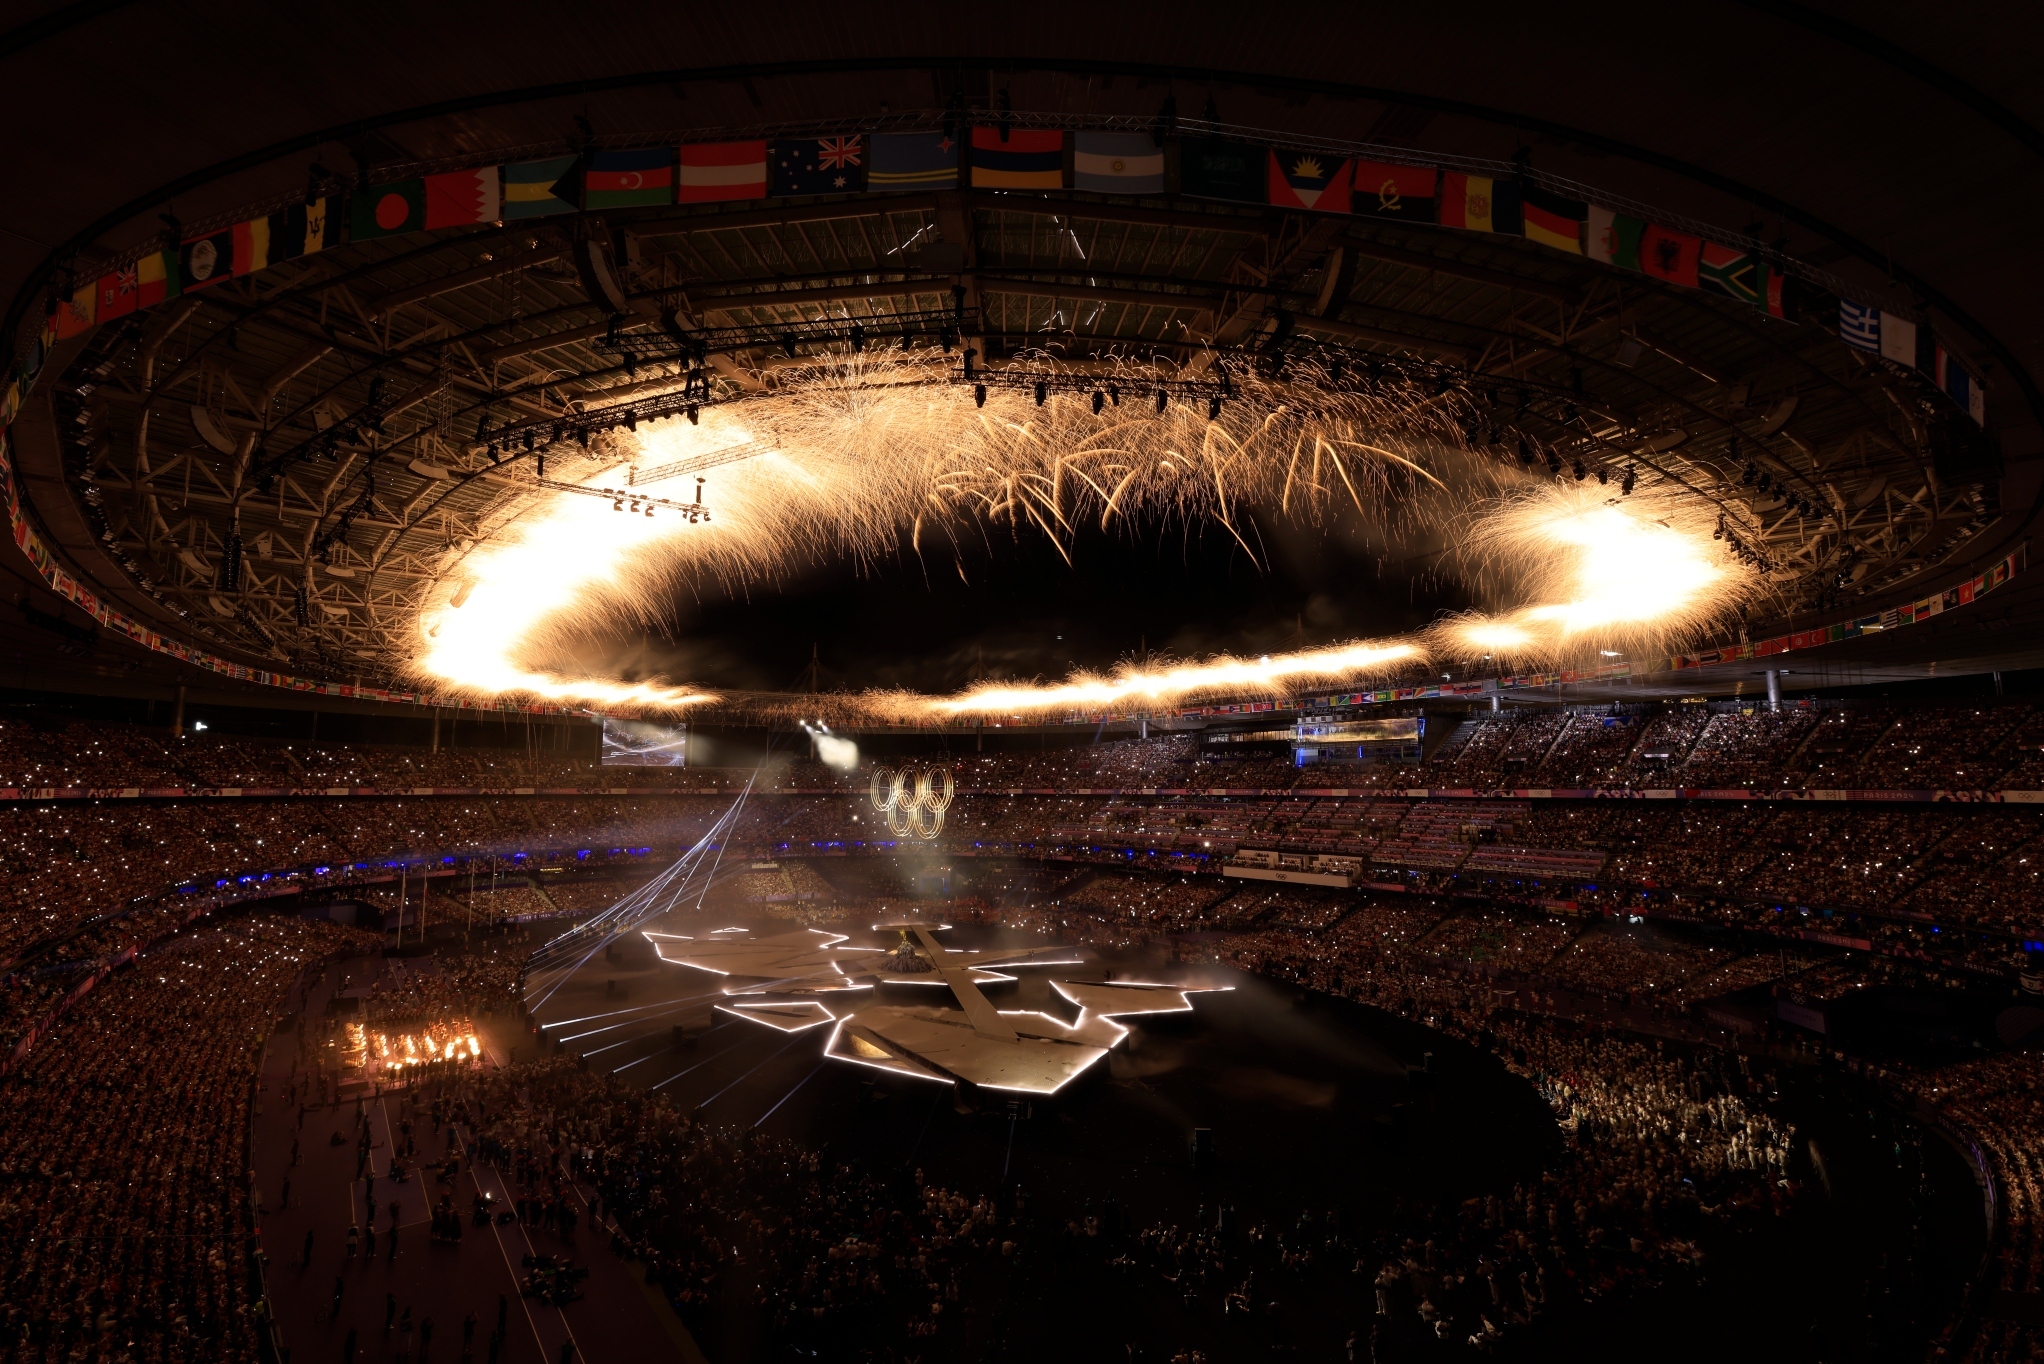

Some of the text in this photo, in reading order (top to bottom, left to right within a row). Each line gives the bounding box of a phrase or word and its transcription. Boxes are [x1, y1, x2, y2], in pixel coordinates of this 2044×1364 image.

[1668, 914, 1686, 922] PARIS
[1817, 934, 1855, 946] PARIS 2024
[1964, 962, 2004, 977] PARIS 2024
